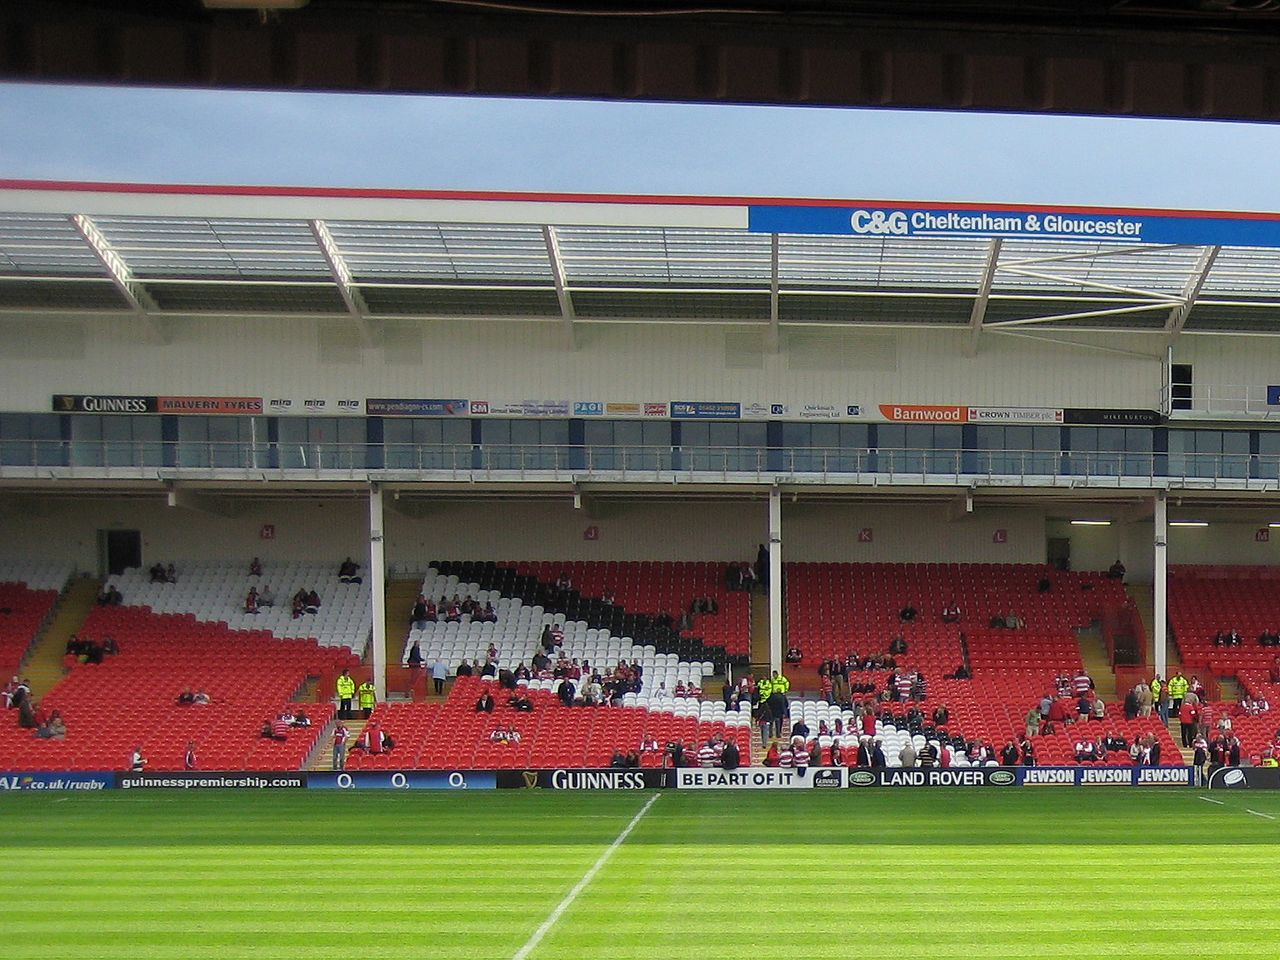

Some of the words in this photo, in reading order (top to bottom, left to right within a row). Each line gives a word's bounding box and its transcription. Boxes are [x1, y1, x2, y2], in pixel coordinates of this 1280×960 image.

[851, 210, 908, 235] C&G
[911, 212, 1021, 231] Cheltenham
[1025, 215, 1041, 231] &
[1043, 216, 1142, 235] Gloucester
[83, 396, 147, 411] GUINNESS
[163, 400, 219, 409] MALVERN
[224, 400, 262, 410] TYRES
[270, 399, 291, 407] mira
[304, 399, 326, 407] mira
[893, 408, 960, 420] Barnwood
[552, 770, 645, 789] GUINNESS
[683, 773, 703, 786] BE
[707, 773, 749, 786] PART
[752, 773, 775, 786] OF
[778, 773, 794, 785] IT
[881, 772, 924, 785] LAND
[930, 771, 984, 785] ROVER
[1023, 770, 1074, 783] JEWSON
[1080, 769, 1132, 782] JEWSON
[1138, 769, 1188, 782] JEWSON
[122, 777, 301, 789] guinnesspremiership.com
